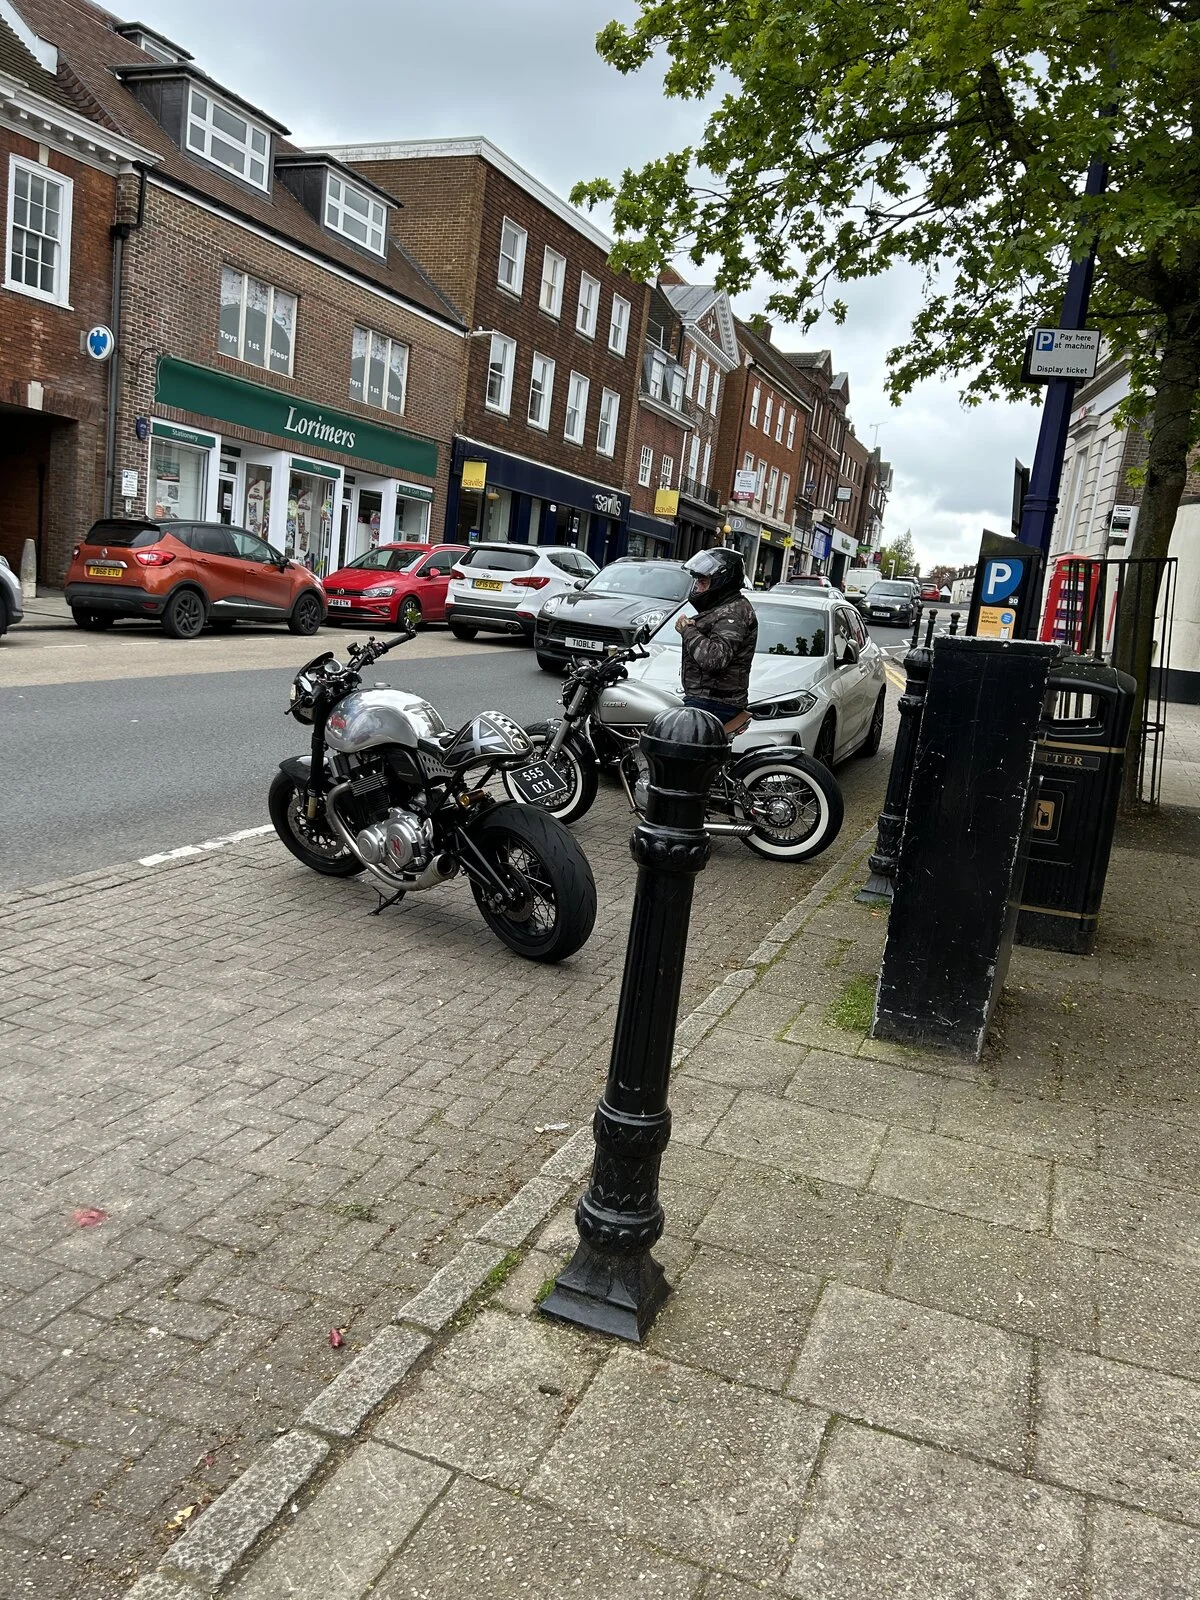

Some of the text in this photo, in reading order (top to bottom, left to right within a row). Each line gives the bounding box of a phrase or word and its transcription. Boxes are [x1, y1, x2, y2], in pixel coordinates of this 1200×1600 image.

[1060, 333, 1073, 341] Pay
[220, 330, 288, 361] Toys 1st Floor
[1036, 365, 1088, 374] Display ticket
[284, 405, 356, 448] Lorimers
[171, 428, 199, 442] Stationery
[463, 479, 484, 487] savills
[595, 494, 621, 516] savills
[655, 505, 677, 514] savills
[522, 767, 544, 781] 555
[531, 778, 555, 793] OTX
